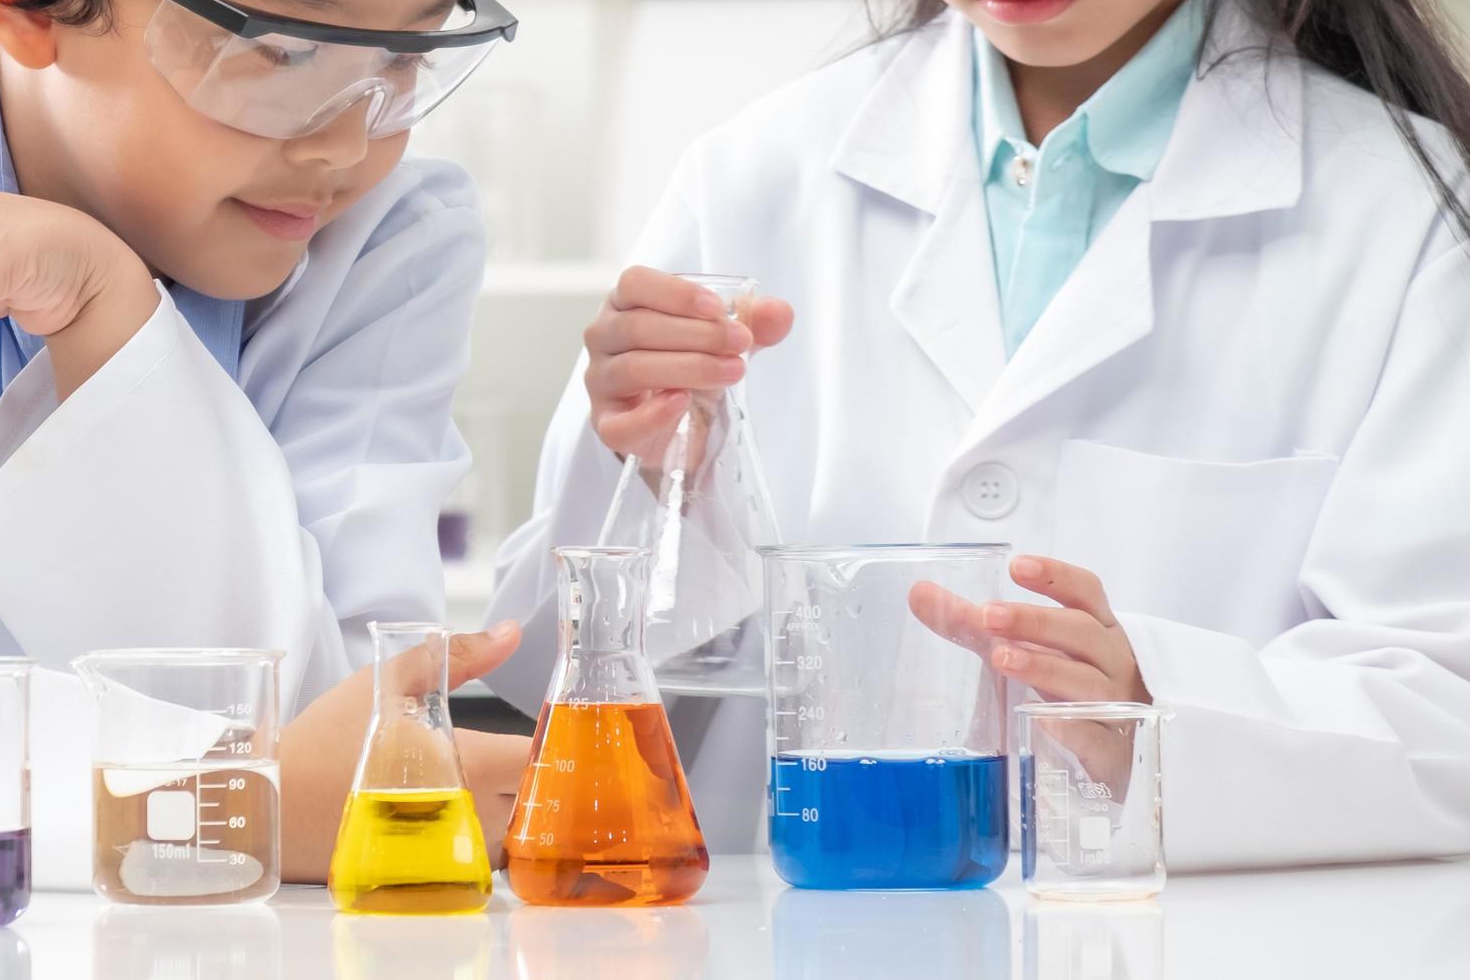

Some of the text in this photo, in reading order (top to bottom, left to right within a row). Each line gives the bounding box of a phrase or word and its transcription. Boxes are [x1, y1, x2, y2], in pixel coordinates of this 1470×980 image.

[795, 604, 822, 620] 400
[796, 655, 823, 670] 320
[228, 704, 251, 716] 150
[567, 696, 590, 711] 125
[797, 706, 825, 721] 240
[229, 742, 252, 755] 120
[553, 759, 576, 773] 100
[801, 757, 827, 772] 160
[228, 778, 246, 791] 90
[545, 799, 560, 813] 75
[228, 816, 247, 829] 60
[801, 808, 819, 823] 80
[538, 833, 555, 847] 50
[151, 843, 190, 860] 150ml
[228, 853, 247, 866] 30
